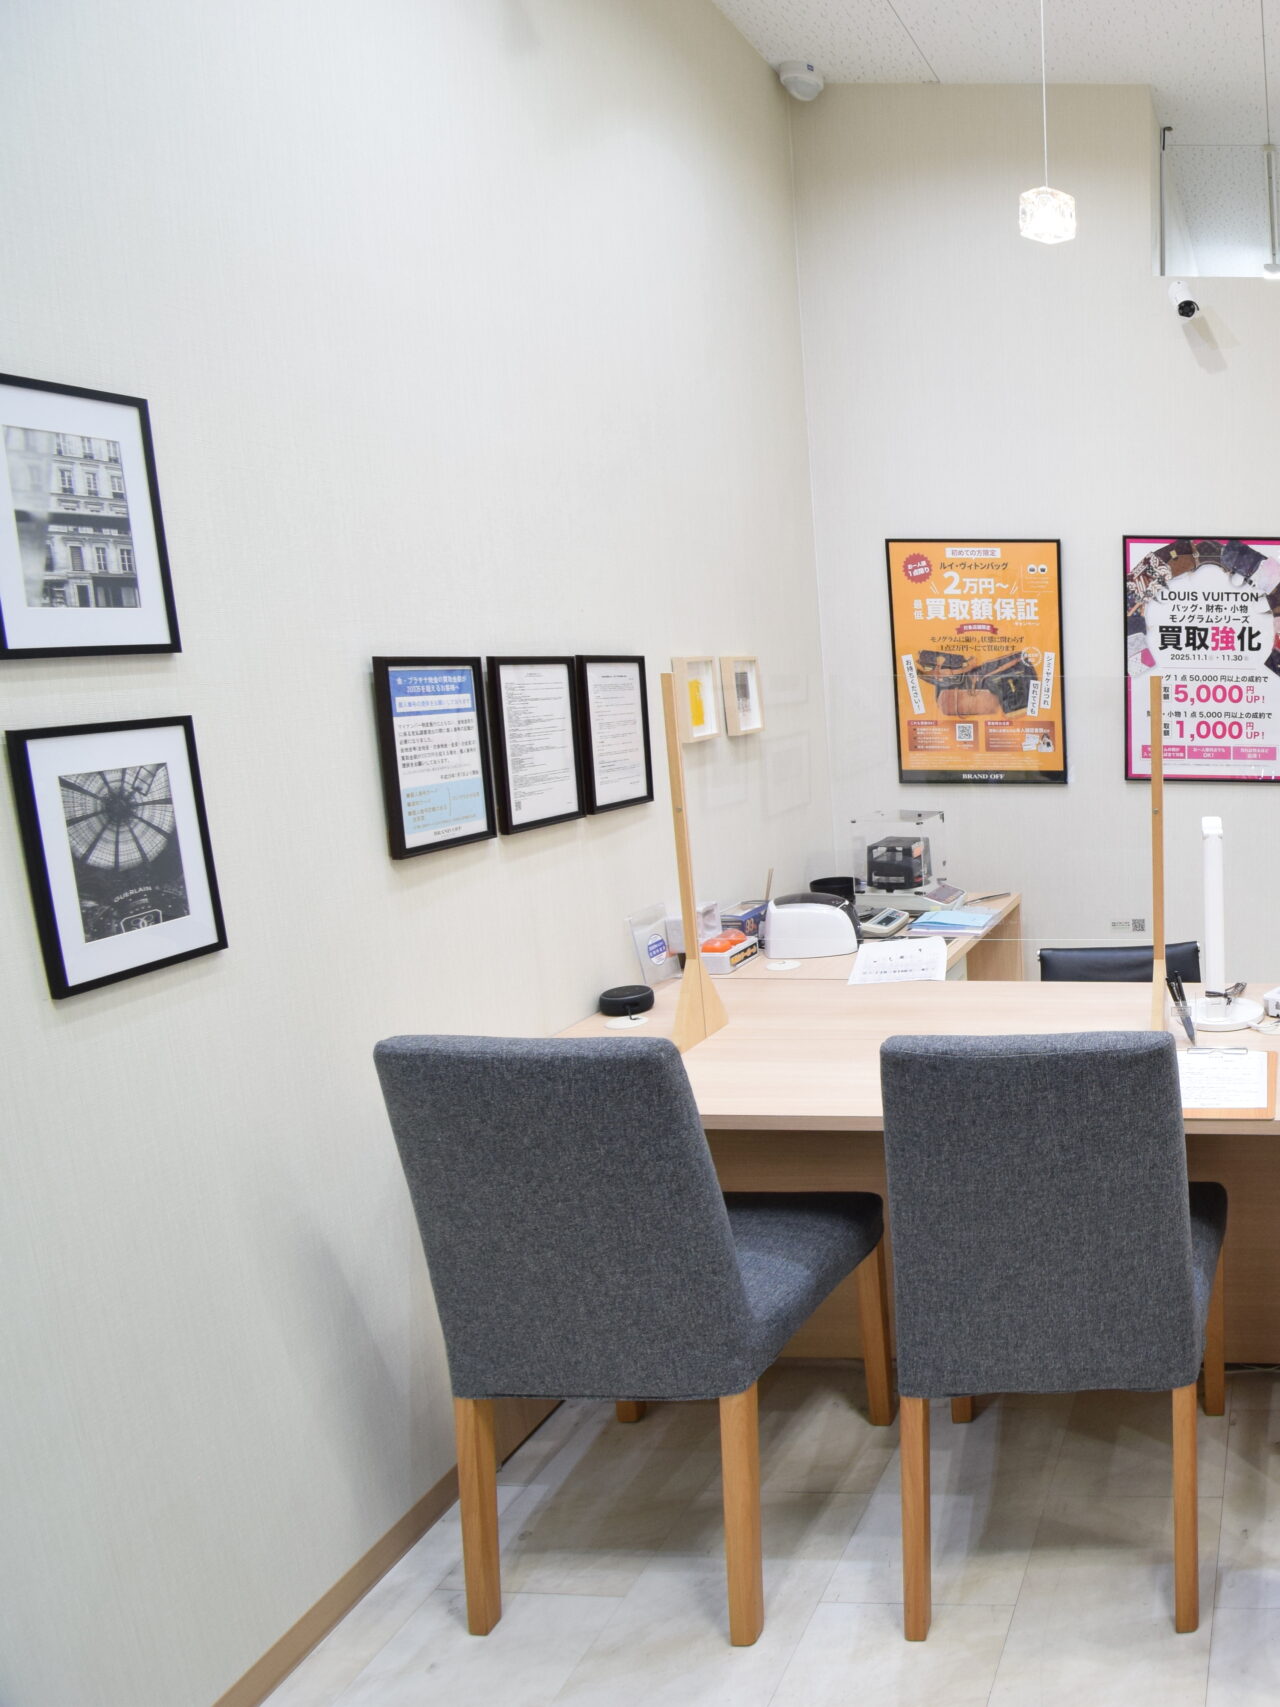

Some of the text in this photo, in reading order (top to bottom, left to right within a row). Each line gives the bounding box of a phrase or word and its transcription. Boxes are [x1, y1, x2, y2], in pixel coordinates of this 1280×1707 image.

[939, 562, 1009, 570] ルイ・ヴィトンバッグ
[1161, 591, 1259, 602] LOUIS VUITTON
[926, 598, 1040, 620] 買取額保証
[1172, 604, 1249, 613] バッグ・財布・小物
[1169, 614, 1250, 623] モノグラムシリーズ
[1158, 625, 1262, 651] 買取強化
[1174, 684, 1243, 706] 5,000
[1246, 686, 1255, 694] 円
[1175, 720, 1243, 742] 1,000
[1246, 722, 1255, 730] 円
